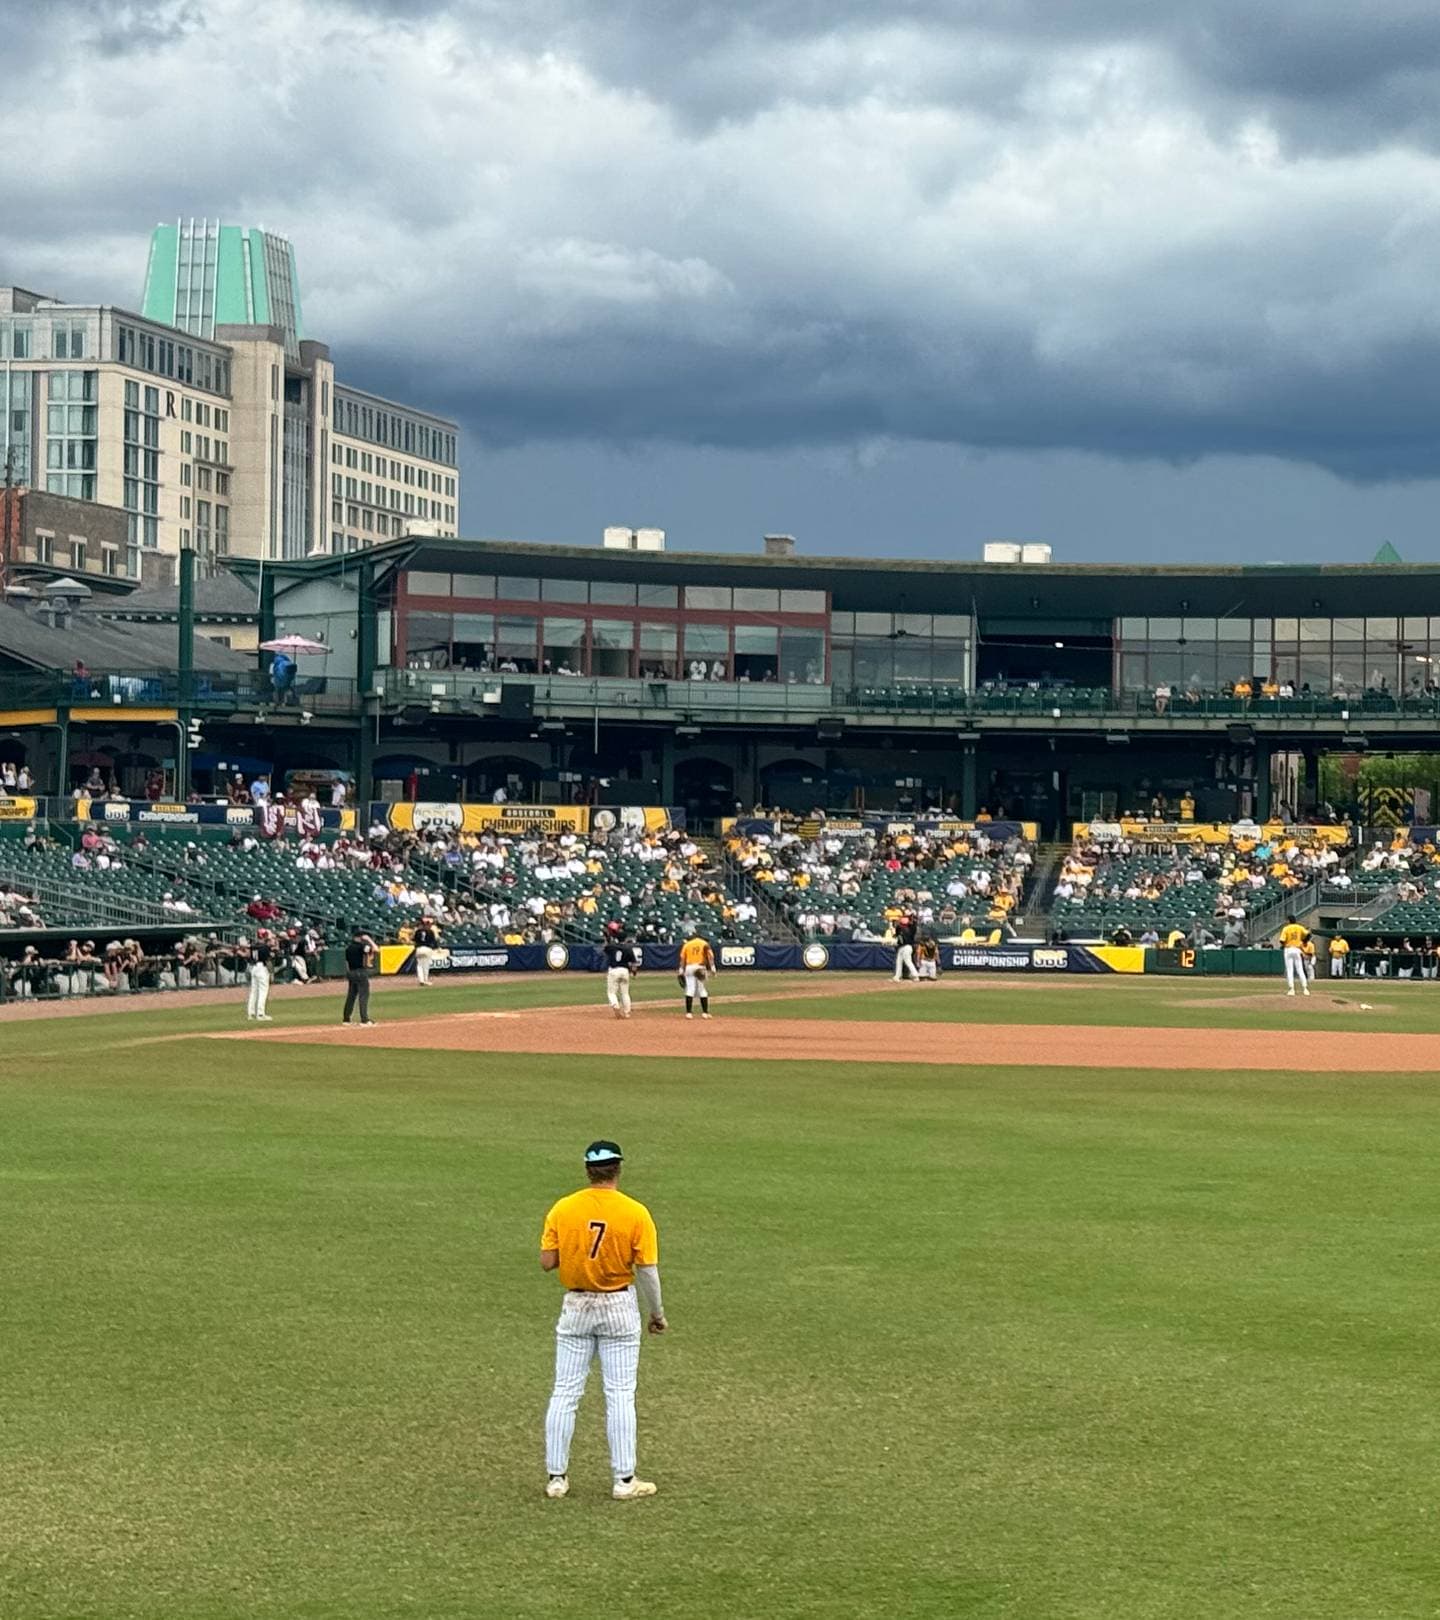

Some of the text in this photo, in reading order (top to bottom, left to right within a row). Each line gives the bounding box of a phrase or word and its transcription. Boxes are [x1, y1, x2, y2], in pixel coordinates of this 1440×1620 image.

[166, 391, 177, 419] R
[481, 819, 576, 831] CHAMPIONSHIPS
[953, 955, 1030, 967] CHAMPIONSHIP
[1181, 949, 1195, 968] 12
[588, 1219, 607, 1261] 7
